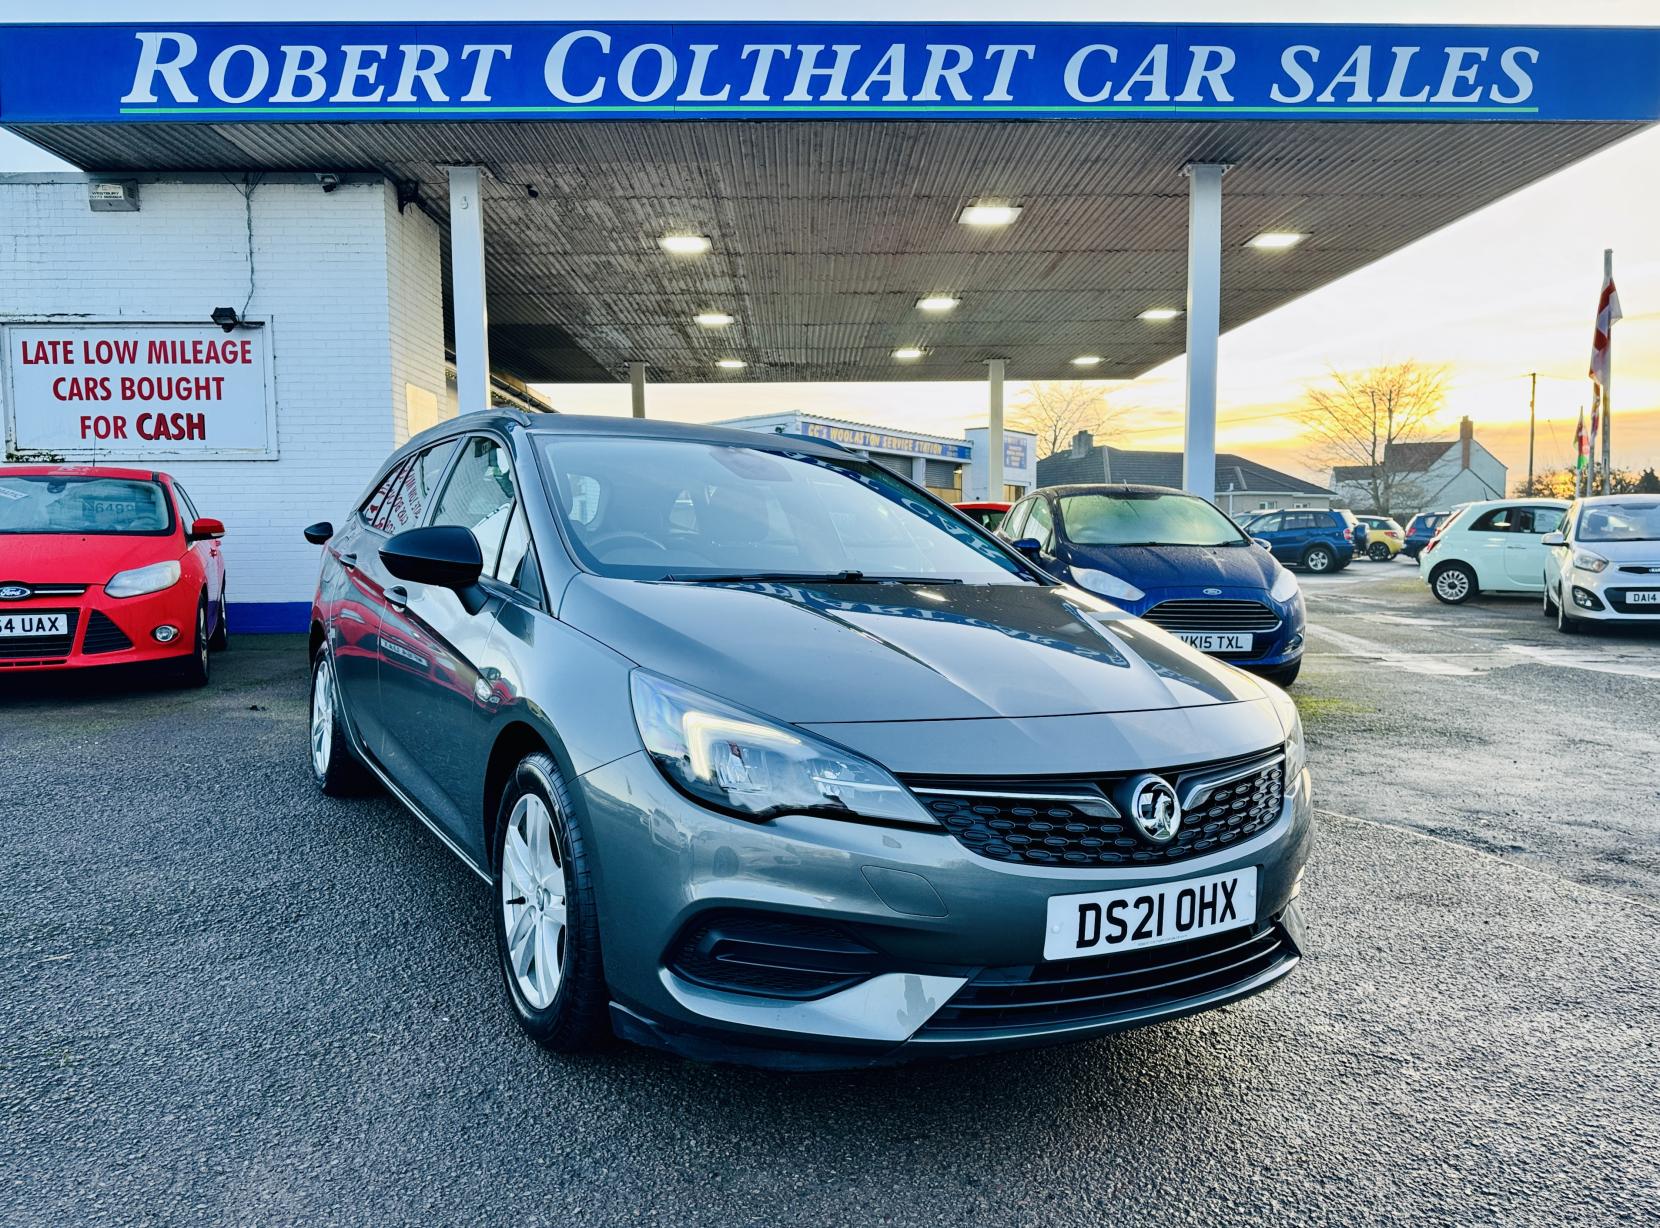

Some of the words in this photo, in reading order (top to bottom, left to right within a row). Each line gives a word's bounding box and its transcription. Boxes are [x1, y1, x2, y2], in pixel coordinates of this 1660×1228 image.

[1063, 43, 1237, 103] CAR
[1269, 44, 1540, 105] SALES
[21, 340, 74, 365] LATE
[83, 340, 138, 365] LOW
[147, 340, 252, 364] MILEAGE
[52, 377, 112, 401] CARS
[121, 376, 225, 401] BOUGHT
[80, 415, 127, 440] FOR
[136, 412, 206, 441] CASH
[883, 434, 913, 452] SERVICE
[915, 440, 943, 456] STATION
[1633, 594, 1657, 602] DA14
[21, 616, 60, 632] UAX
[1216, 636, 1244, 649] TXL
[1076, 893, 1165, 948] DS21
[1175, 878, 1238, 932] OHX
